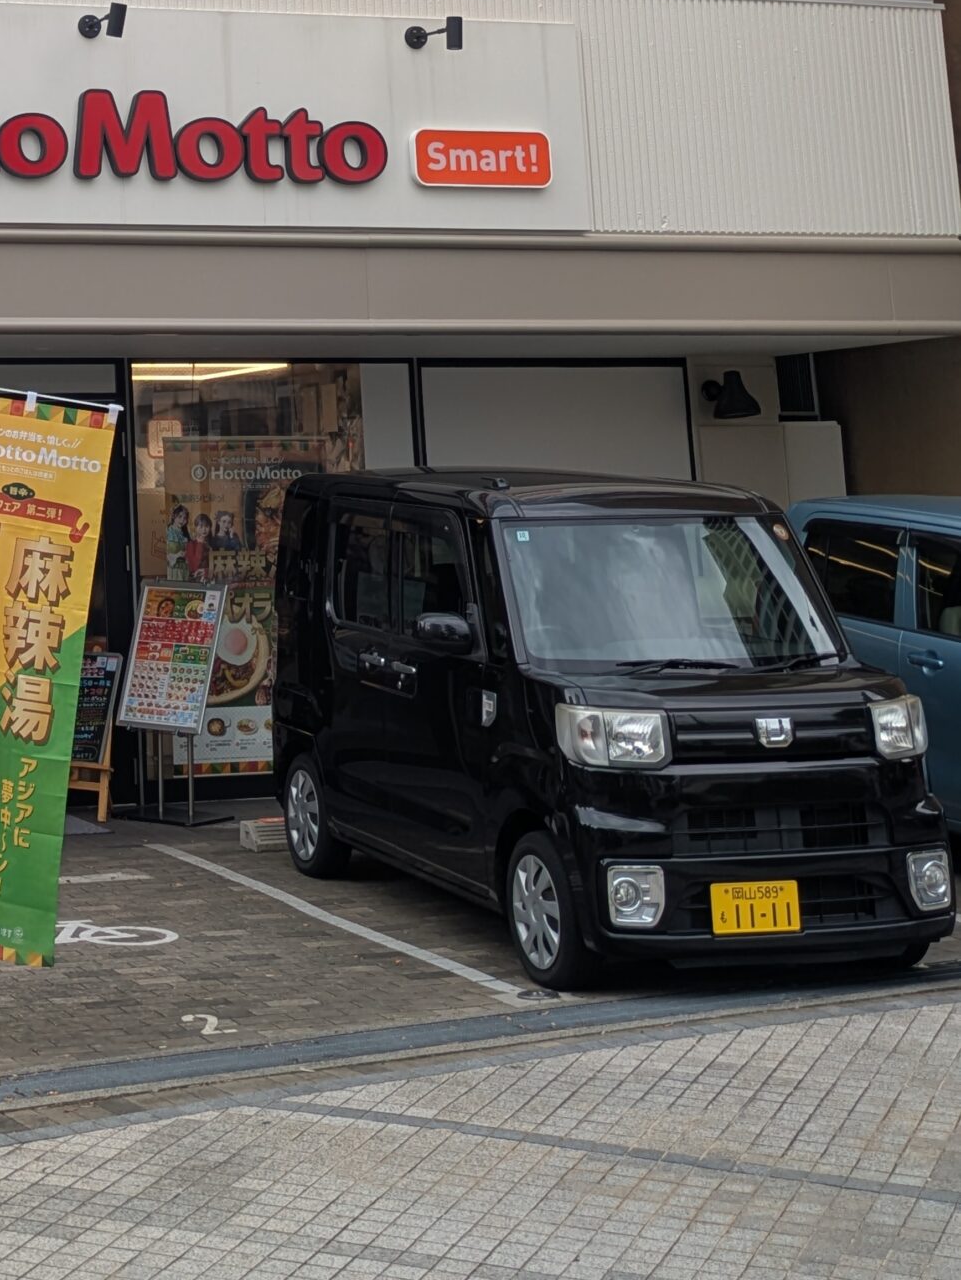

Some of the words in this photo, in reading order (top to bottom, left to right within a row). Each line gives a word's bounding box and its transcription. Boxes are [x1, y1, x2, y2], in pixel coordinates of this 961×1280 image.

[426, 140, 538, 173] Smart!
[26, 503, 63, 520] 第二弾!
[209, 546, 276, 579] 麻辣
[0, 535, 75, 745] 麻辣湯
[13, 757, 38, 849] アジアに
[735, 902, 792, 929] 11-11
[181, 1013, 236, 1036] 2
